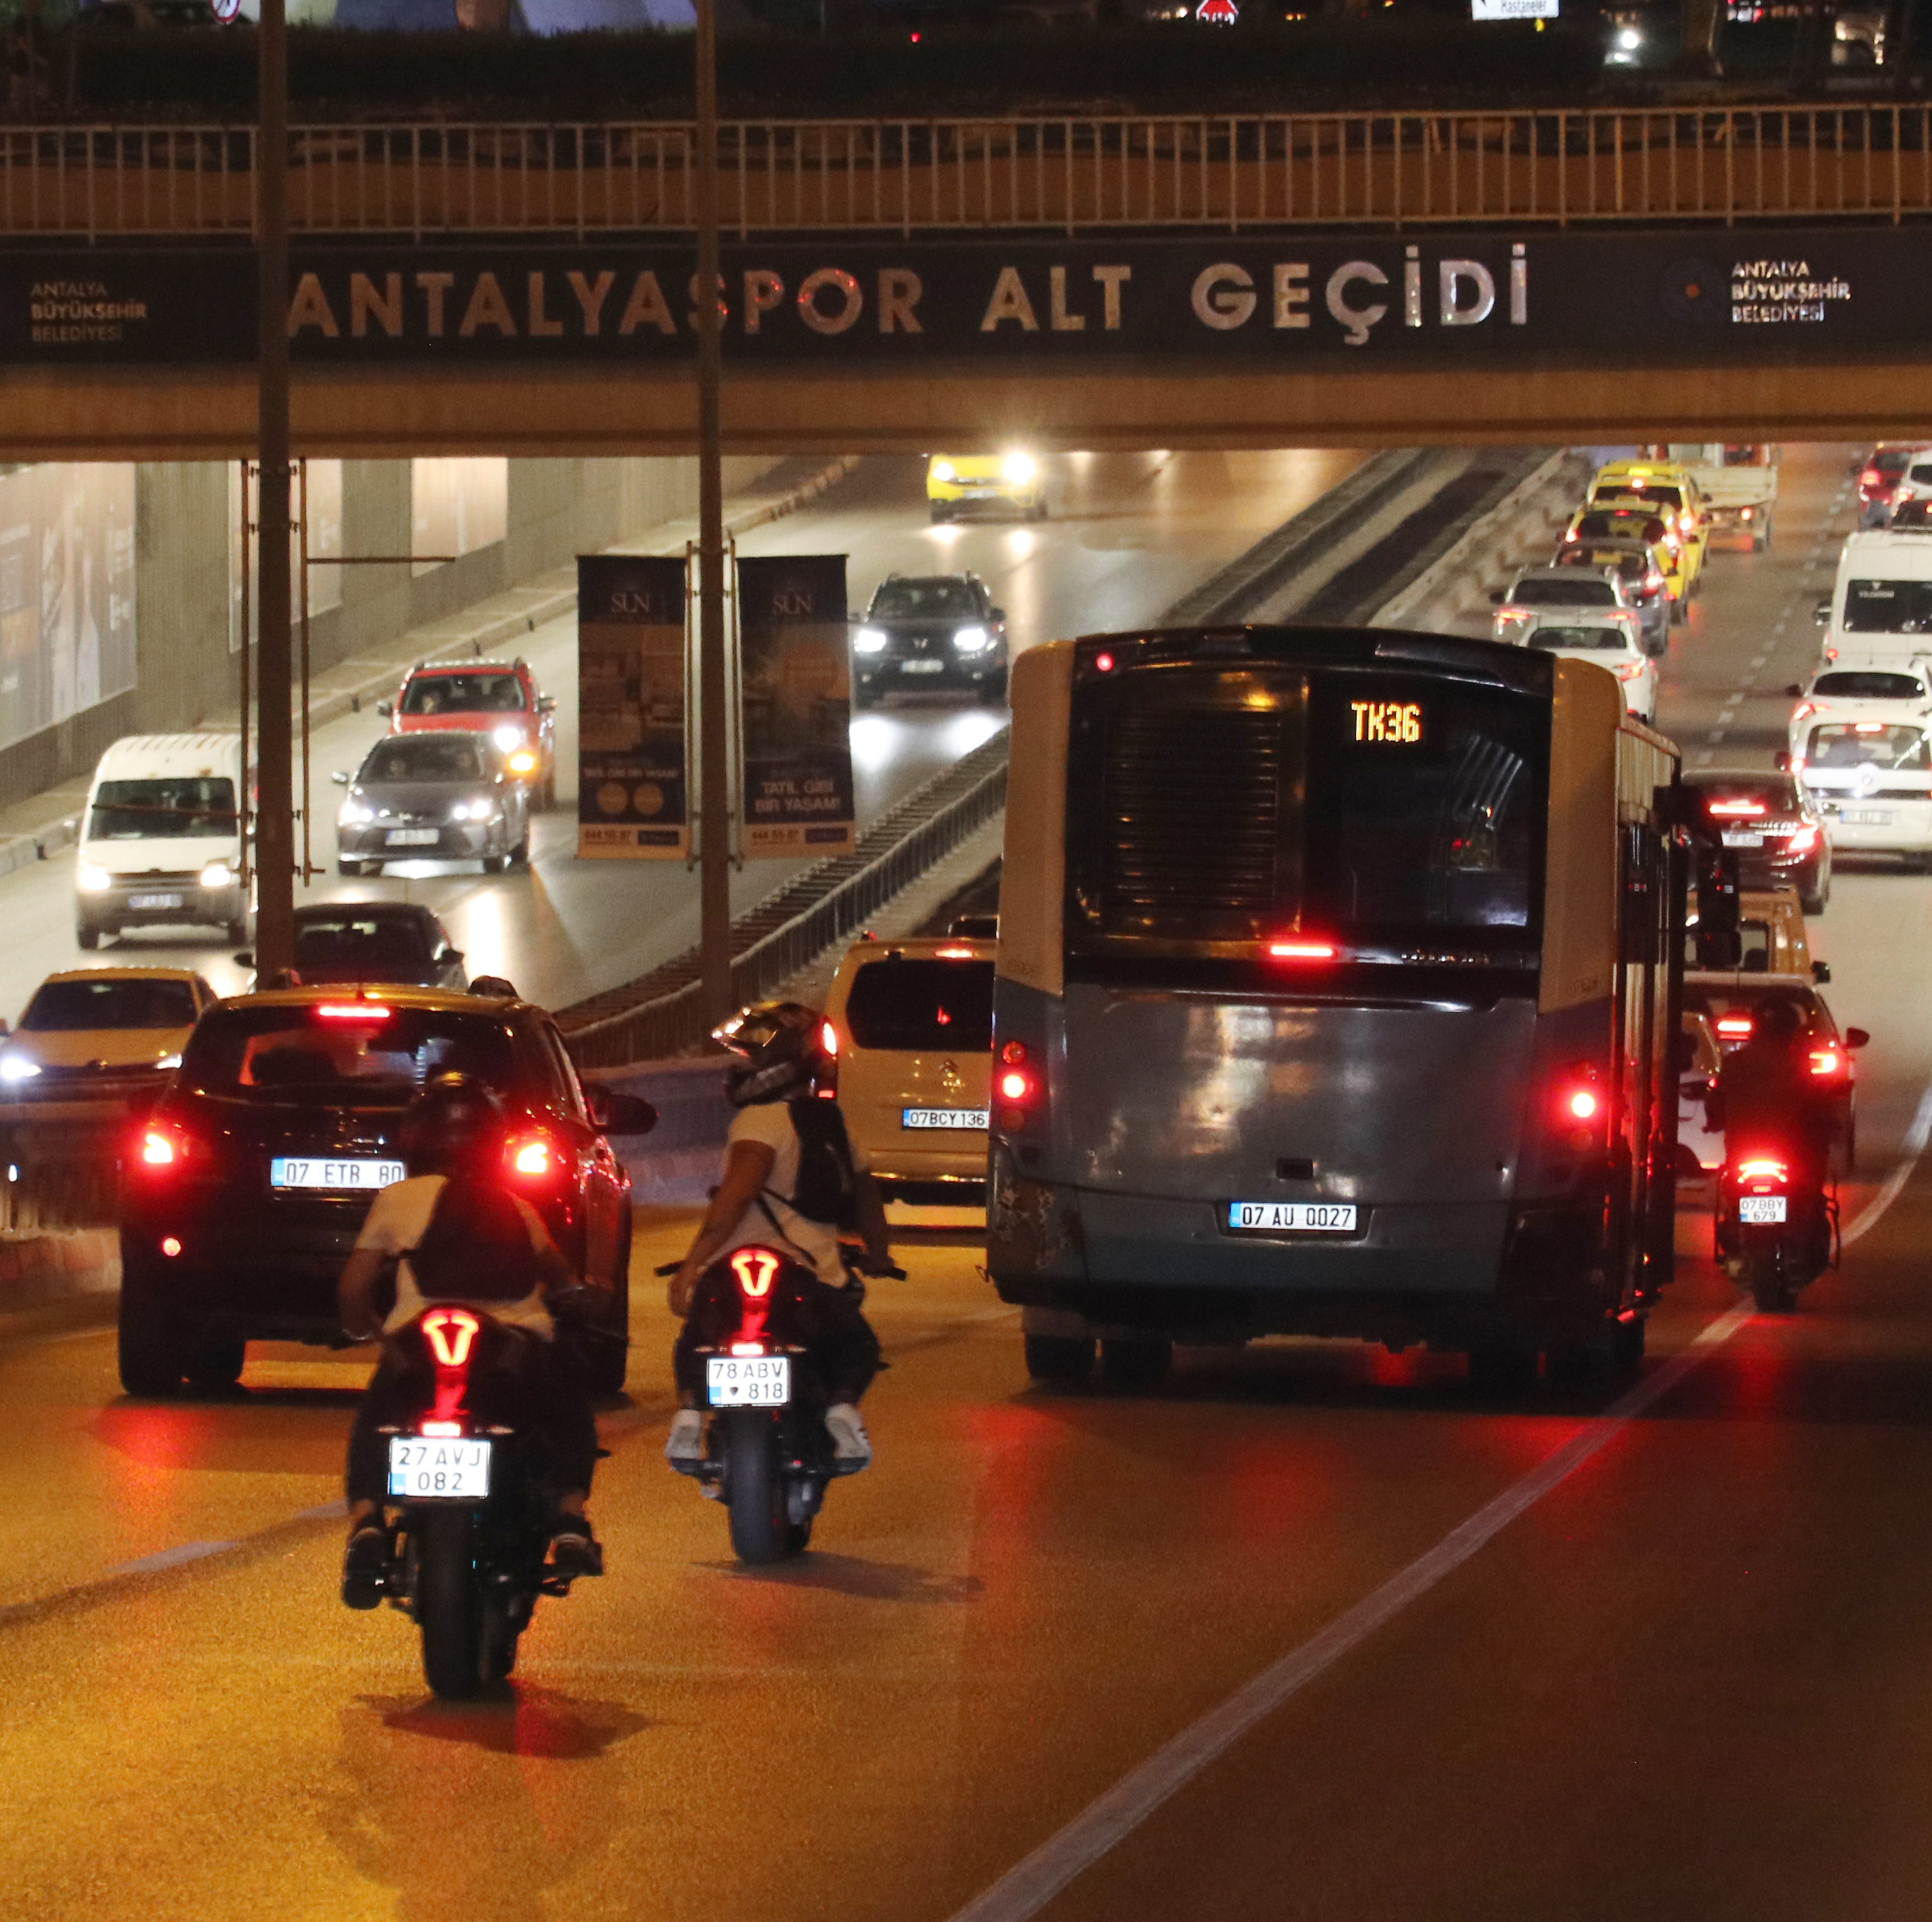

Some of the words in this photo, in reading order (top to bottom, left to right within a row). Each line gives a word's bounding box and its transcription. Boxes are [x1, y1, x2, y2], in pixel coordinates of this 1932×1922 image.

[1731, 260, 1811, 278] ANTALYA
[31, 282, 108, 297] ANTALYA
[980, 265, 1131, 331] ALT
[1191, 243, 1528, 345] GEÇİDİ
[1352, 701, 1421, 743] TK36
[286, 1163, 309, 1184] 07
[325, 1164, 360, 1185] ETB
[1242, 1206, 1265, 1225] 07
[1272, 1207, 1294, 1226] AU
[1306, 1208, 1352, 1226] 0027
[1753, 1211, 1776, 1221] 679
[713, 1363, 738, 1379] 78
[743, 1362, 783, 1379] ABV
[748, 1383, 783, 1399] 818
[398, 1447, 428, 1465] 27
[435, 1447, 481, 1466] AVJ
[418, 1472, 463, 1491] 082
